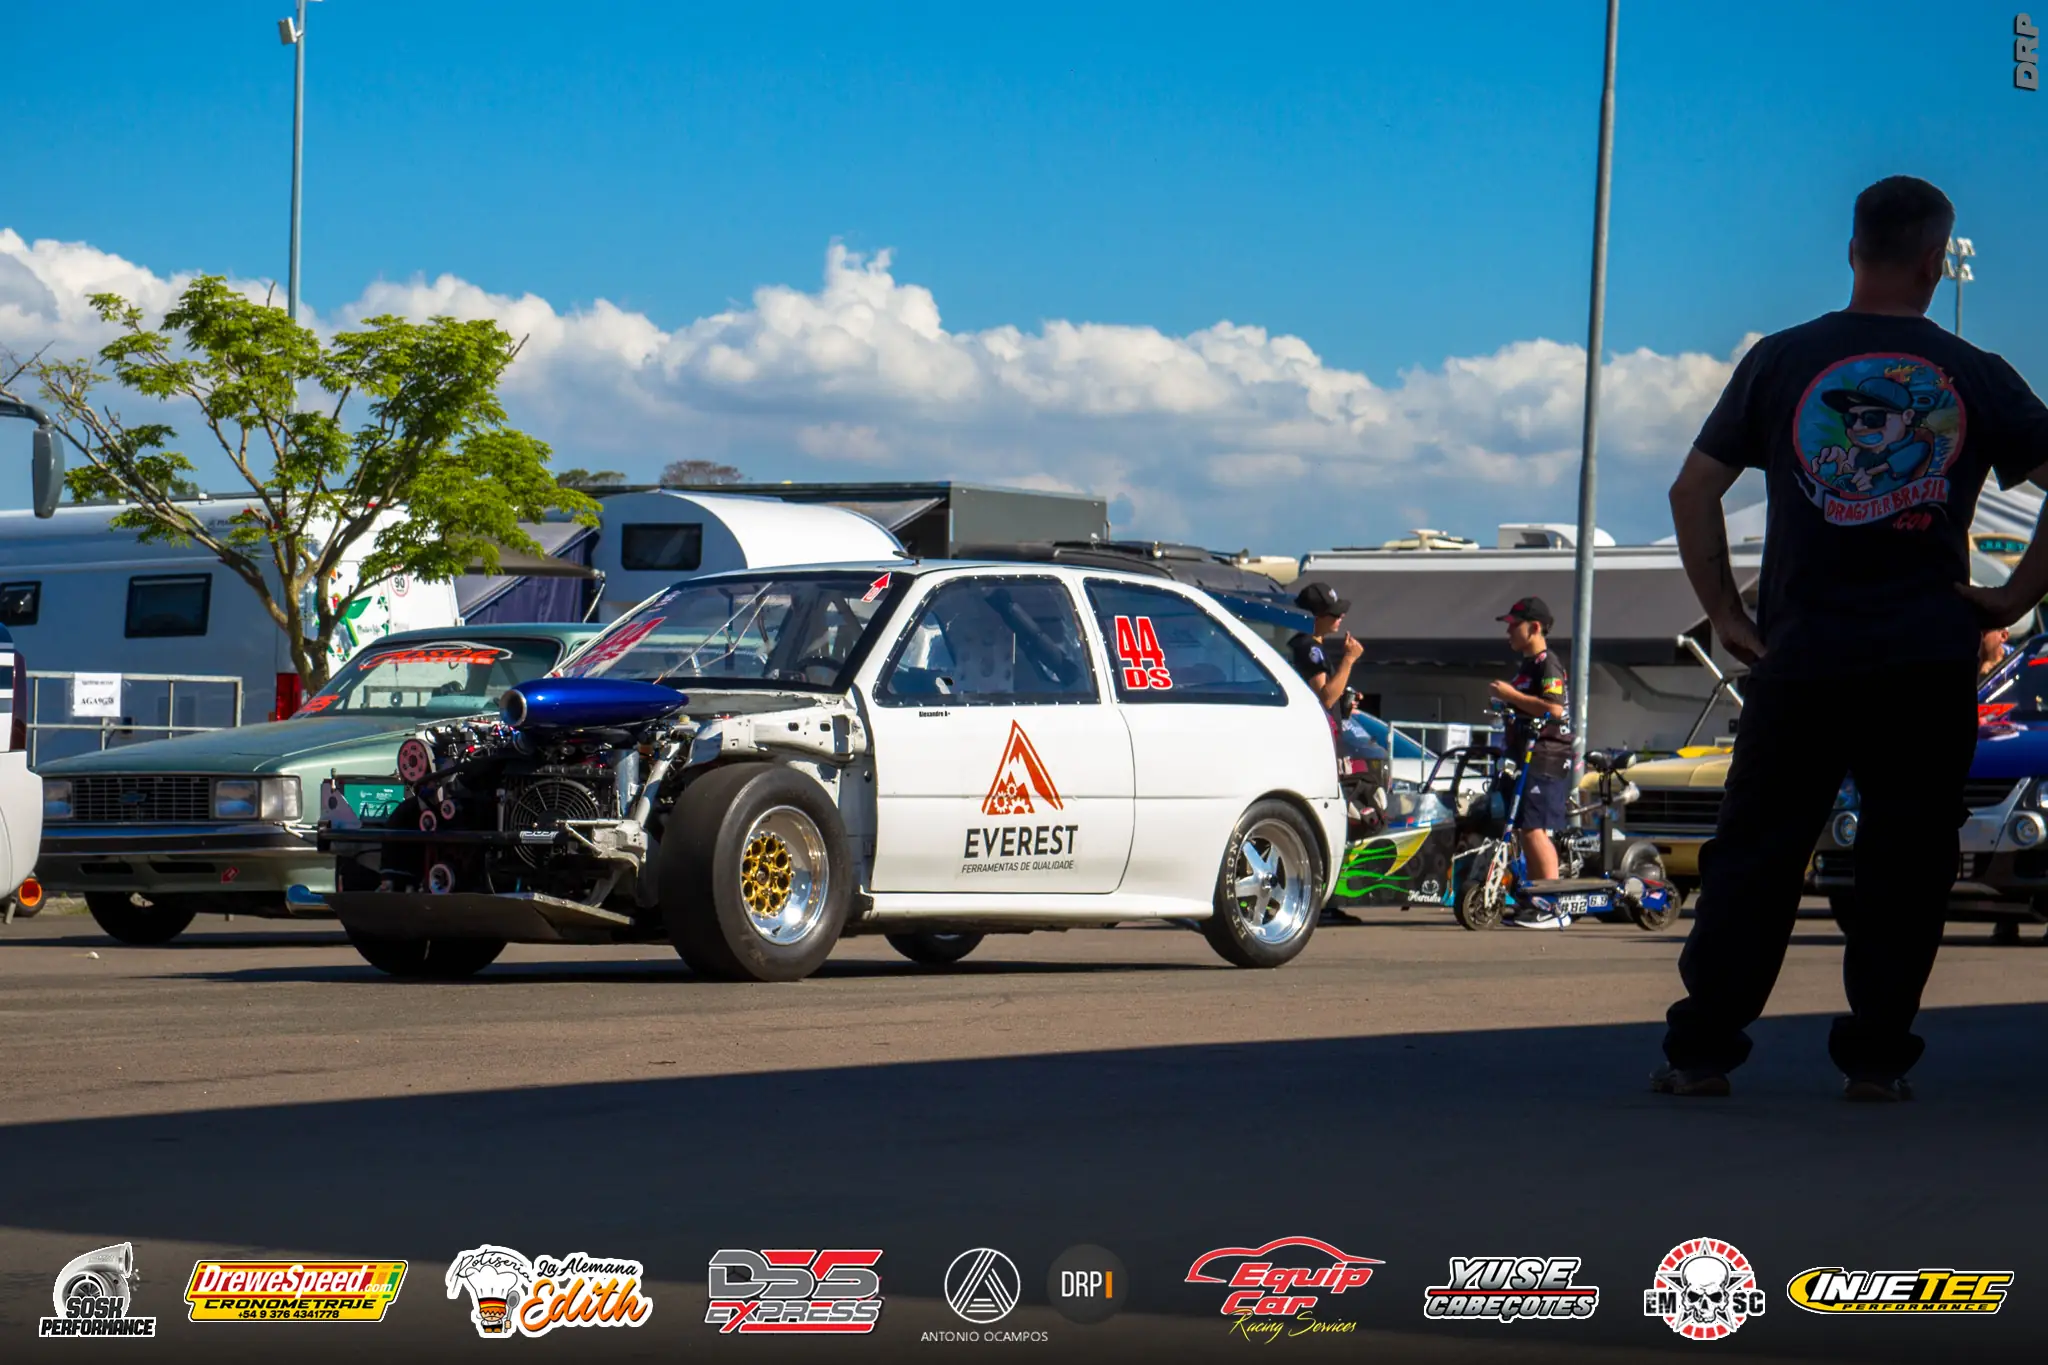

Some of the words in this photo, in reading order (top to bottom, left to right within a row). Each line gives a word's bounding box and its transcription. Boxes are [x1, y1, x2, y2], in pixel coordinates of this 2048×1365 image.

[394, 577, 406, 588] 90
[1114, 615, 1166, 668] 44
[1123, 667, 1173, 690] DS
[963, 824, 1079, 859] EVEREST
[961, 862, 1018, 874] FERRAMENTAS
[1020, 861, 1031, 871] DE
[1032, 859, 1075, 871] QUALIDADE
